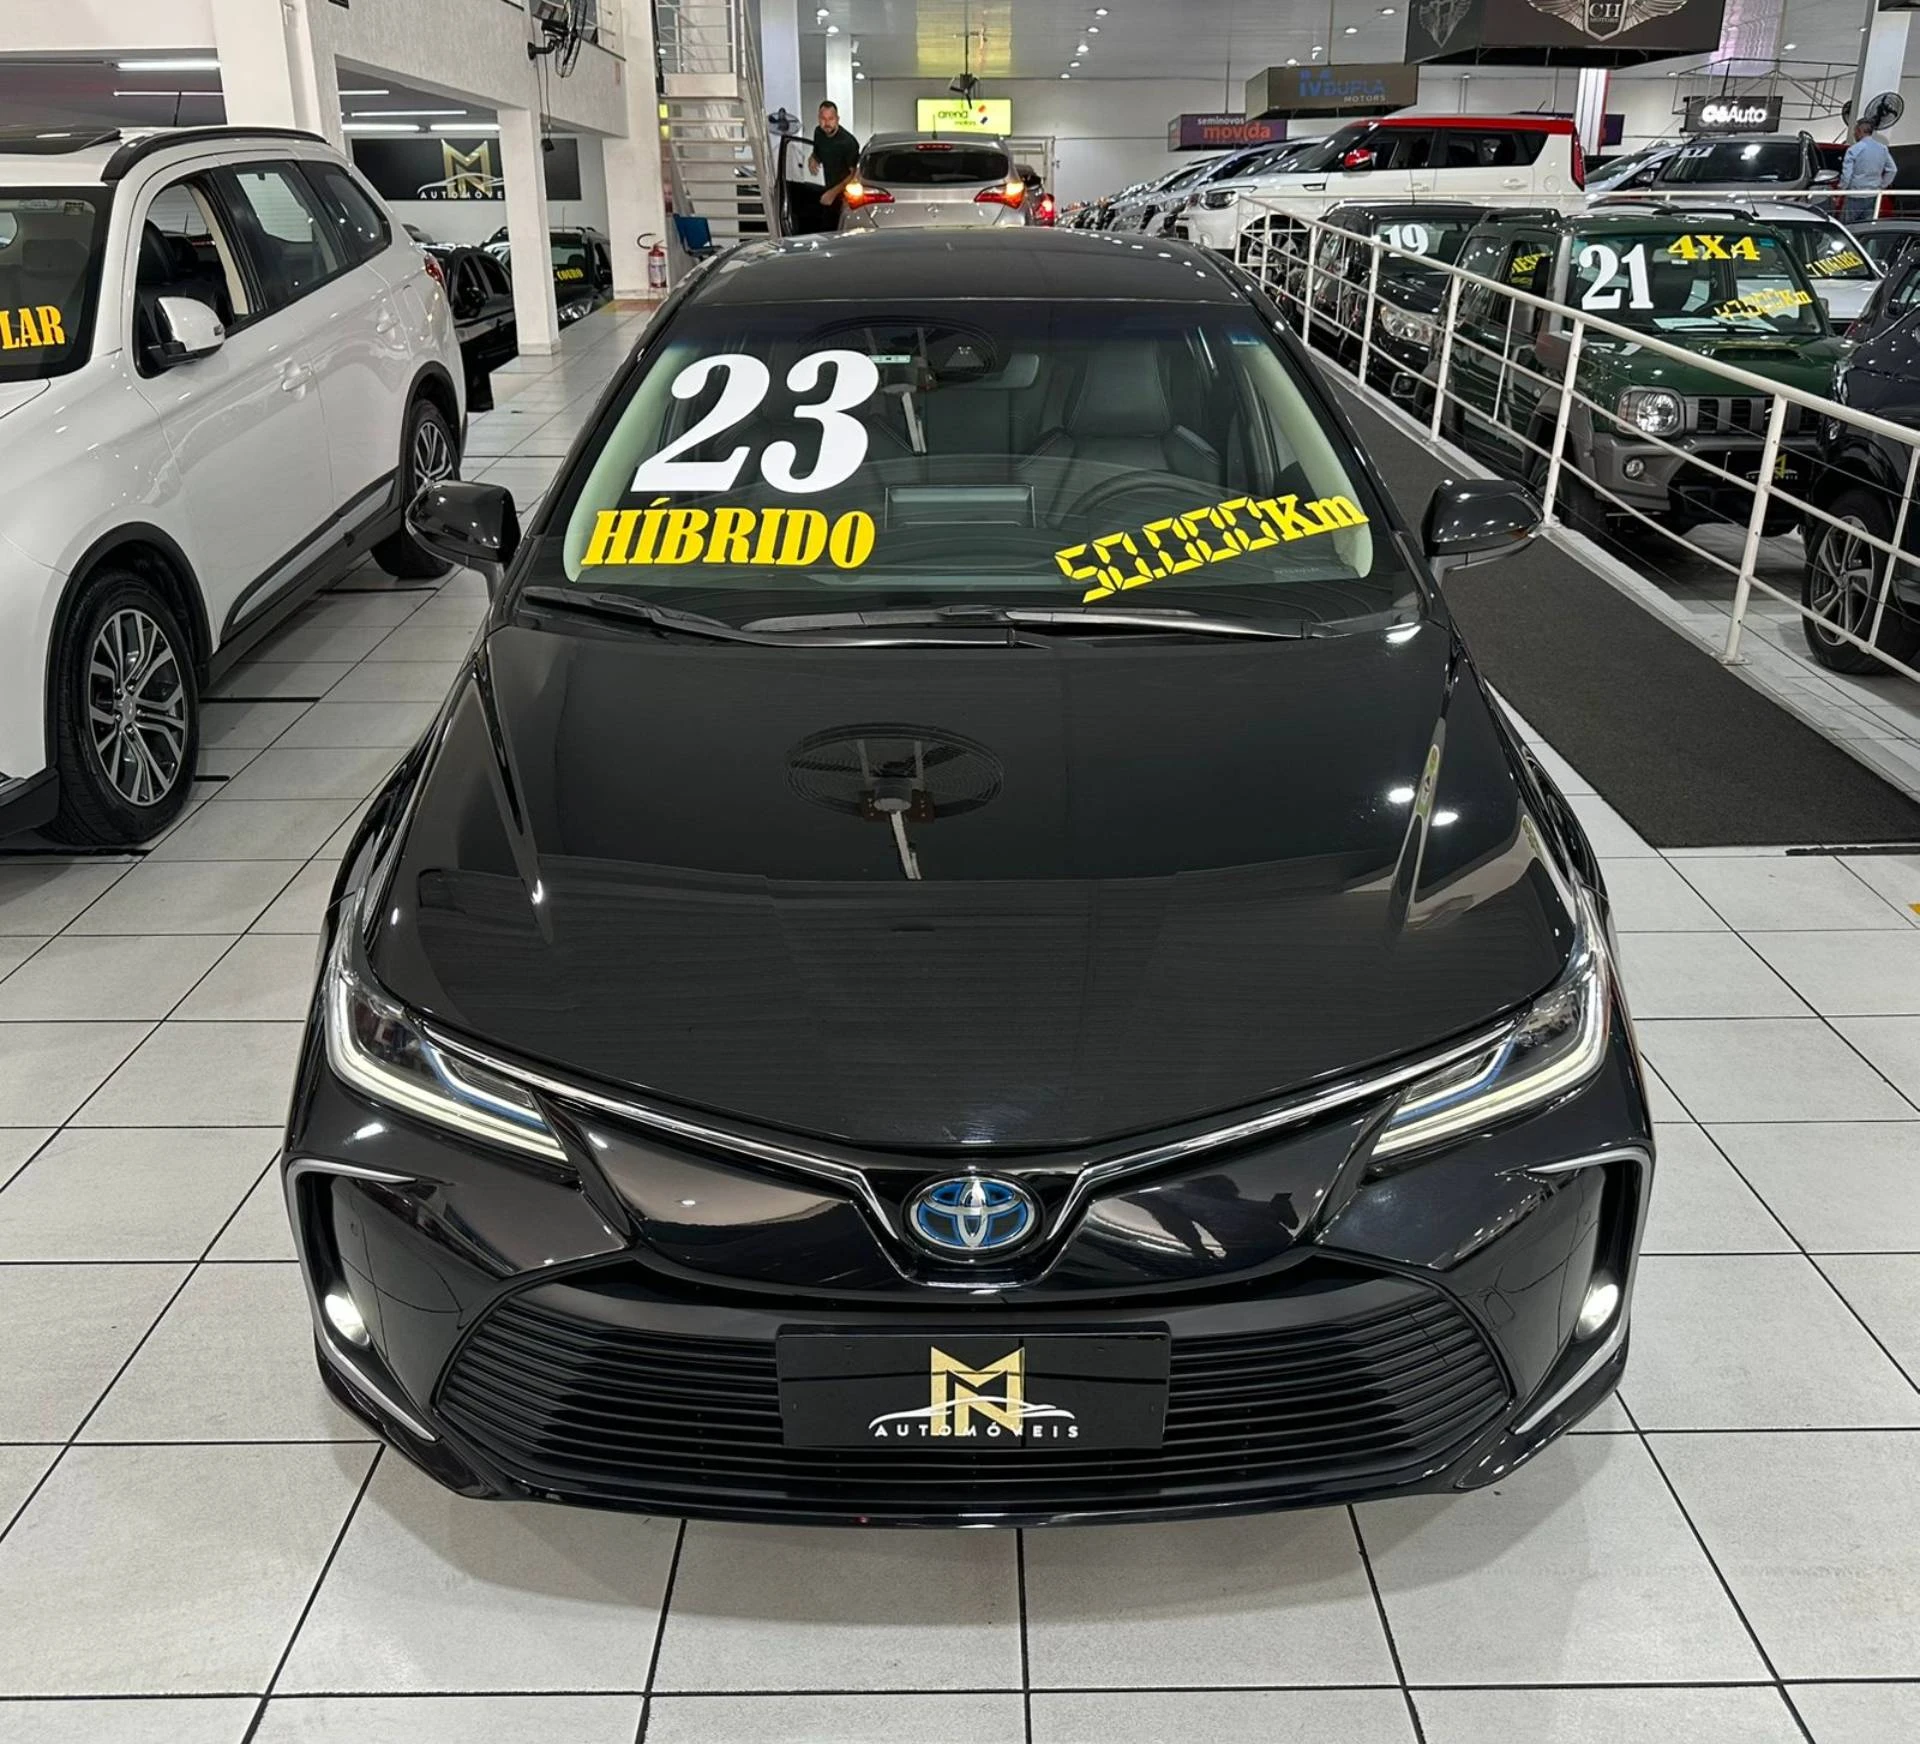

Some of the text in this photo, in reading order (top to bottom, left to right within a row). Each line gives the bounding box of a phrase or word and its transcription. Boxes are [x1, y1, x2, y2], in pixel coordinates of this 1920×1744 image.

[1589, 2, 1621, 18] CH
[1344, 95, 1386, 103] MOTORS
[938, 110, 968, 119] arena
[1197, 115, 1245, 126] seminovos
[420, 190, 504, 200] AUTOMÓVE
[1385, 223, 1429, 258] 19
[1578, 243, 1655, 310] 21
[630, 349, 880, 494] 23
[581, 497, 876, 569] HÍBRIDO
[1054, 493, 1370, 604] 50.000Km
[874, 1421, 1079, 1438] AUTOMÓVEIS
